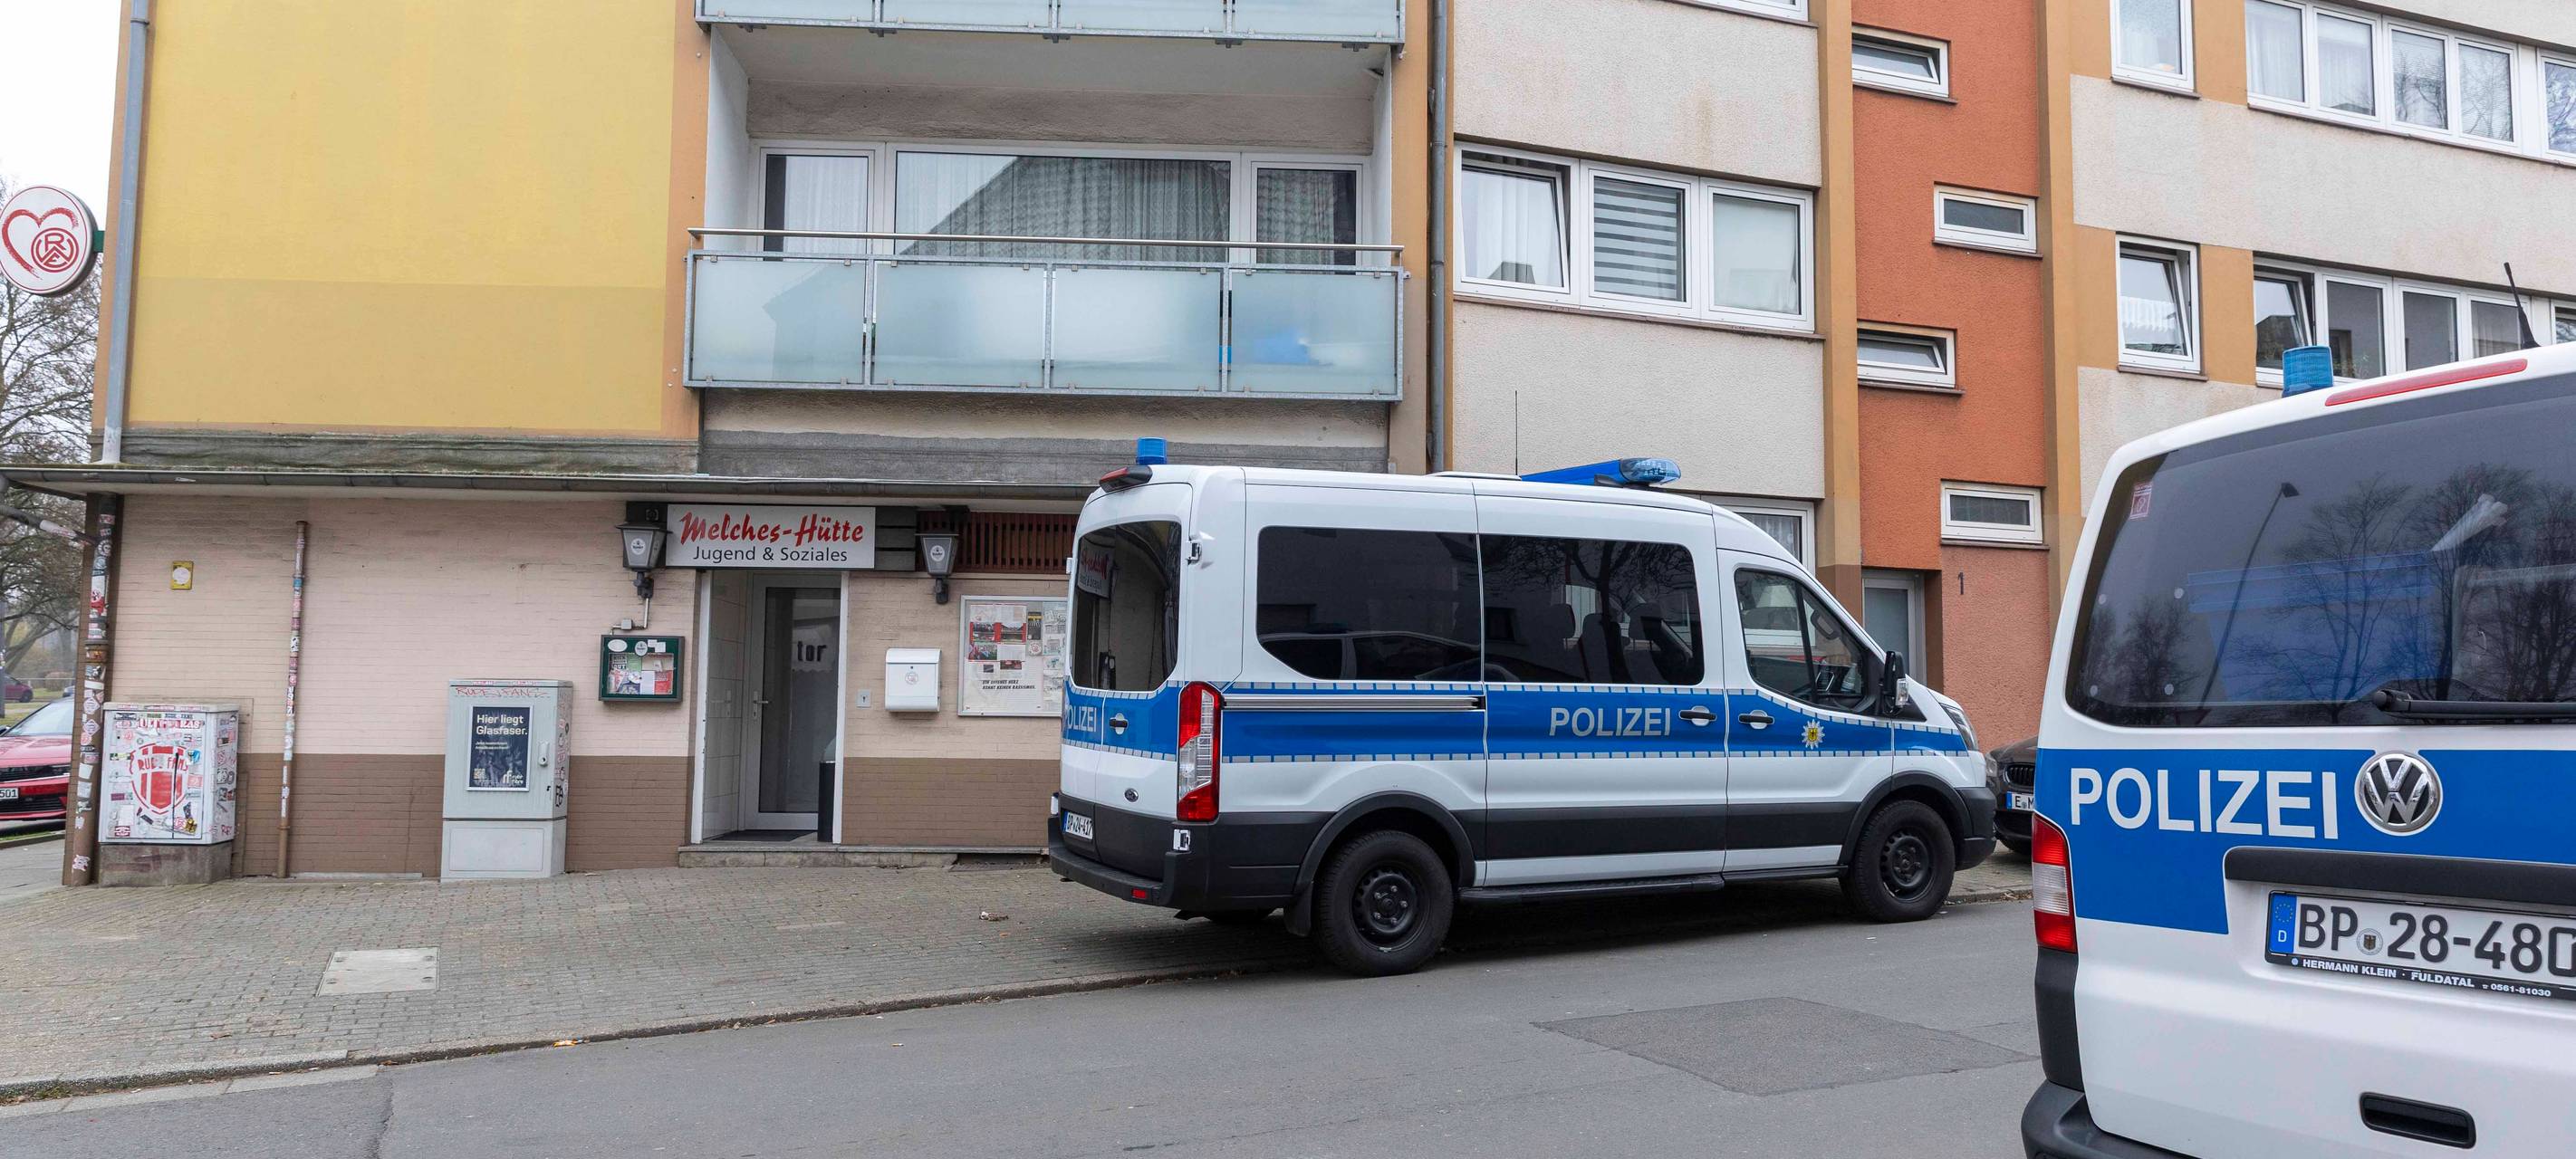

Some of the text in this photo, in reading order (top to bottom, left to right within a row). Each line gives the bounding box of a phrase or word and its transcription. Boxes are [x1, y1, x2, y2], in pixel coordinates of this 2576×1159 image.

[679, 512, 864, 547] Melches-Hütte
[693, 546, 848, 563] Jugend & Soziales
[1957, 571, 1965, 596] 1
[476, 714, 524, 726] Hier liegt
[476, 725, 528, 735] Glasfaser.
[1549, 707, 1671, 736] POLIZEI
[2070, 767, 2339, 839] POLIZEI
[2277, 929, 2287, 943] D
[2298, 903, 2359, 952] BP
[2302, 960, 2475, 989] HERMANN KLEIN FULDATAL
[2490, 982, 2552, 997] 0561-81030
